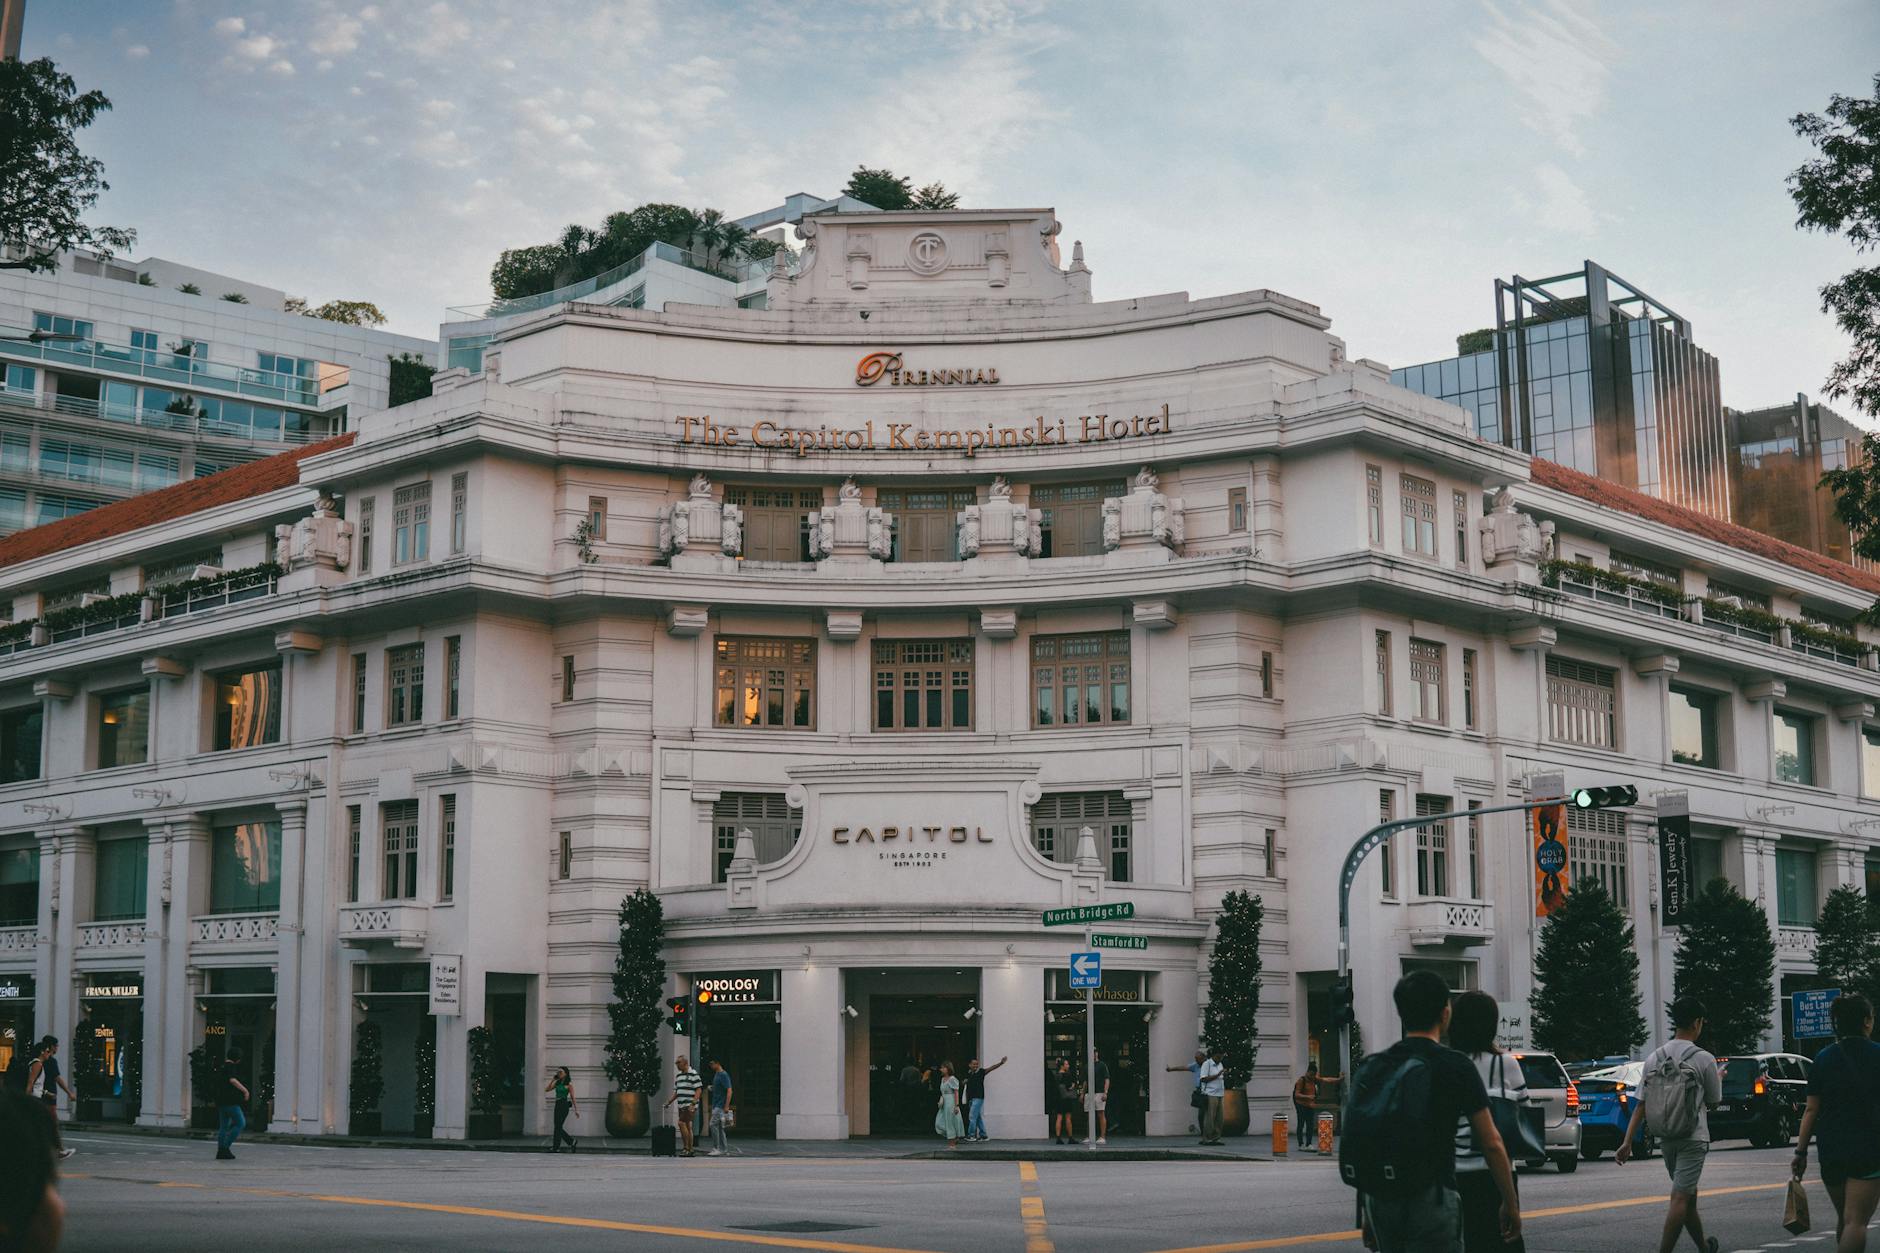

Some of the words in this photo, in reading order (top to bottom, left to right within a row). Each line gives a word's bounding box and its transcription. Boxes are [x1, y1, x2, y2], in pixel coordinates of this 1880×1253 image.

[855, 351, 999, 386] PERENNIAL
[675, 415, 739, 446] The
[752, 420, 875, 457] Capitol
[887, 416, 1066, 458] Kempinski
[1080, 404, 1172, 442] Hotel
[832, 826, 994, 844] CAPITOL
[879, 852, 947, 860] SINGAPORE
[1047, 909, 1076, 922] North
[1079, 906, 1113, 919] Bridge
[1116, 904, 1129, 916] Rd
[1093, 935, 1133, 948] Stamford
[1134, 937, 1145, 948] Rd
[696, 978, 760, 991] HOROLOGY
[1072, 977, 1085, 985] ONE
[1086, 977, 1098, 985] WAY
[85, 986, 111, 997] FRANCK
[111, 986, 139, 996] MULLER
[1800, 1001, 1813, 1010] Bus
[95, 1028, 114, 1037] ZENITH
